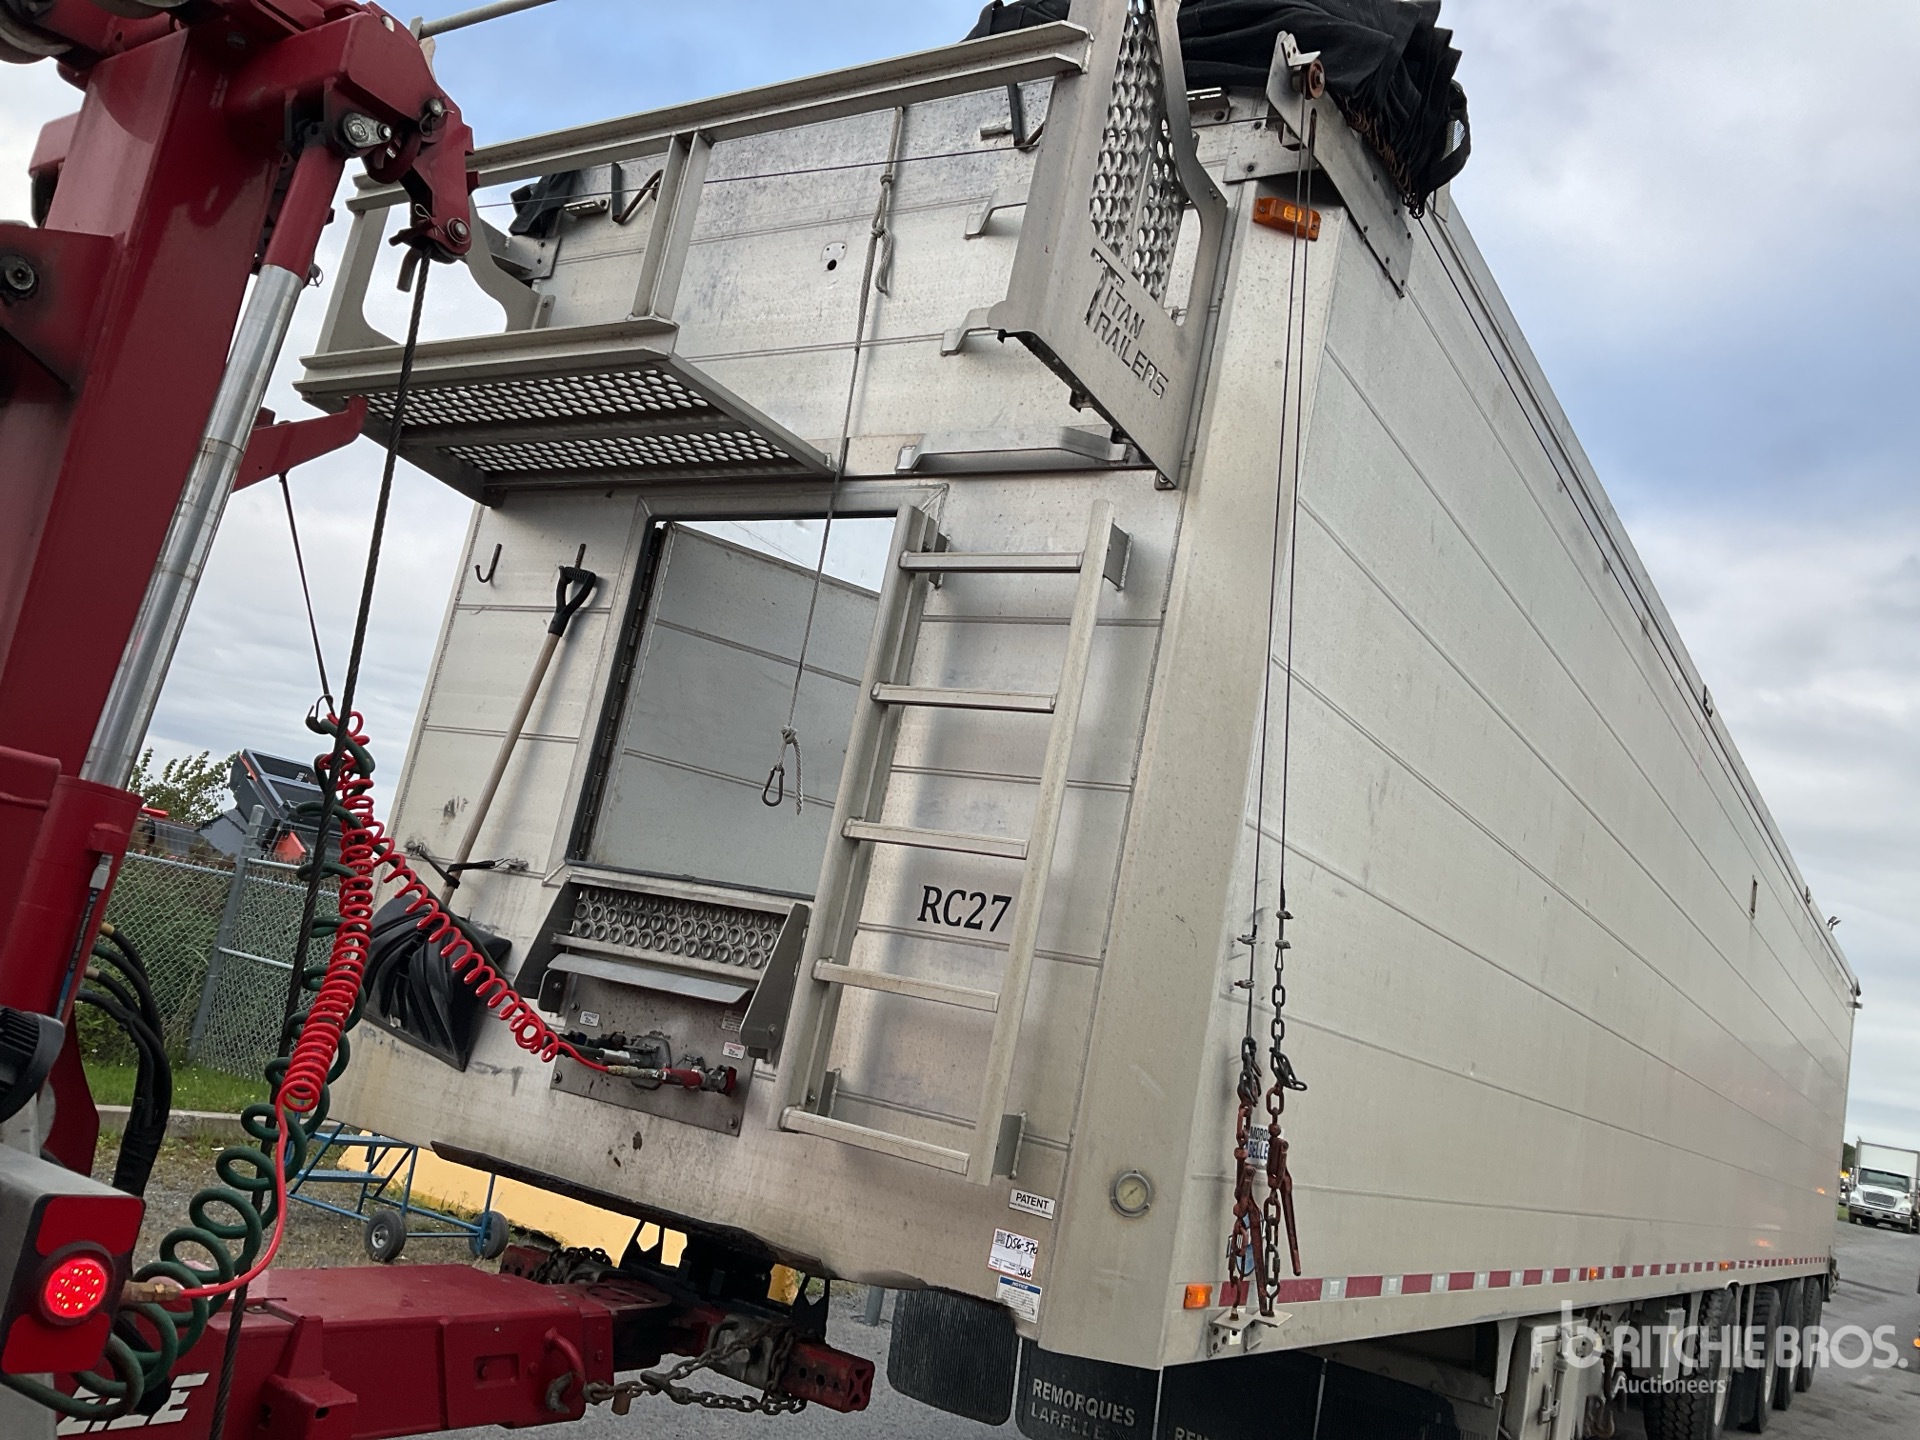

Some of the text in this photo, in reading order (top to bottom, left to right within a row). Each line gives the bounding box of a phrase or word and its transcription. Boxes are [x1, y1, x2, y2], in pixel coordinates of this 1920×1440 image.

[917, 885, 1013, 932] RC27
[1015, 1192, 1050, 1210] PATENT
[1032, 1377, 1136, 1427] REMORQUES
